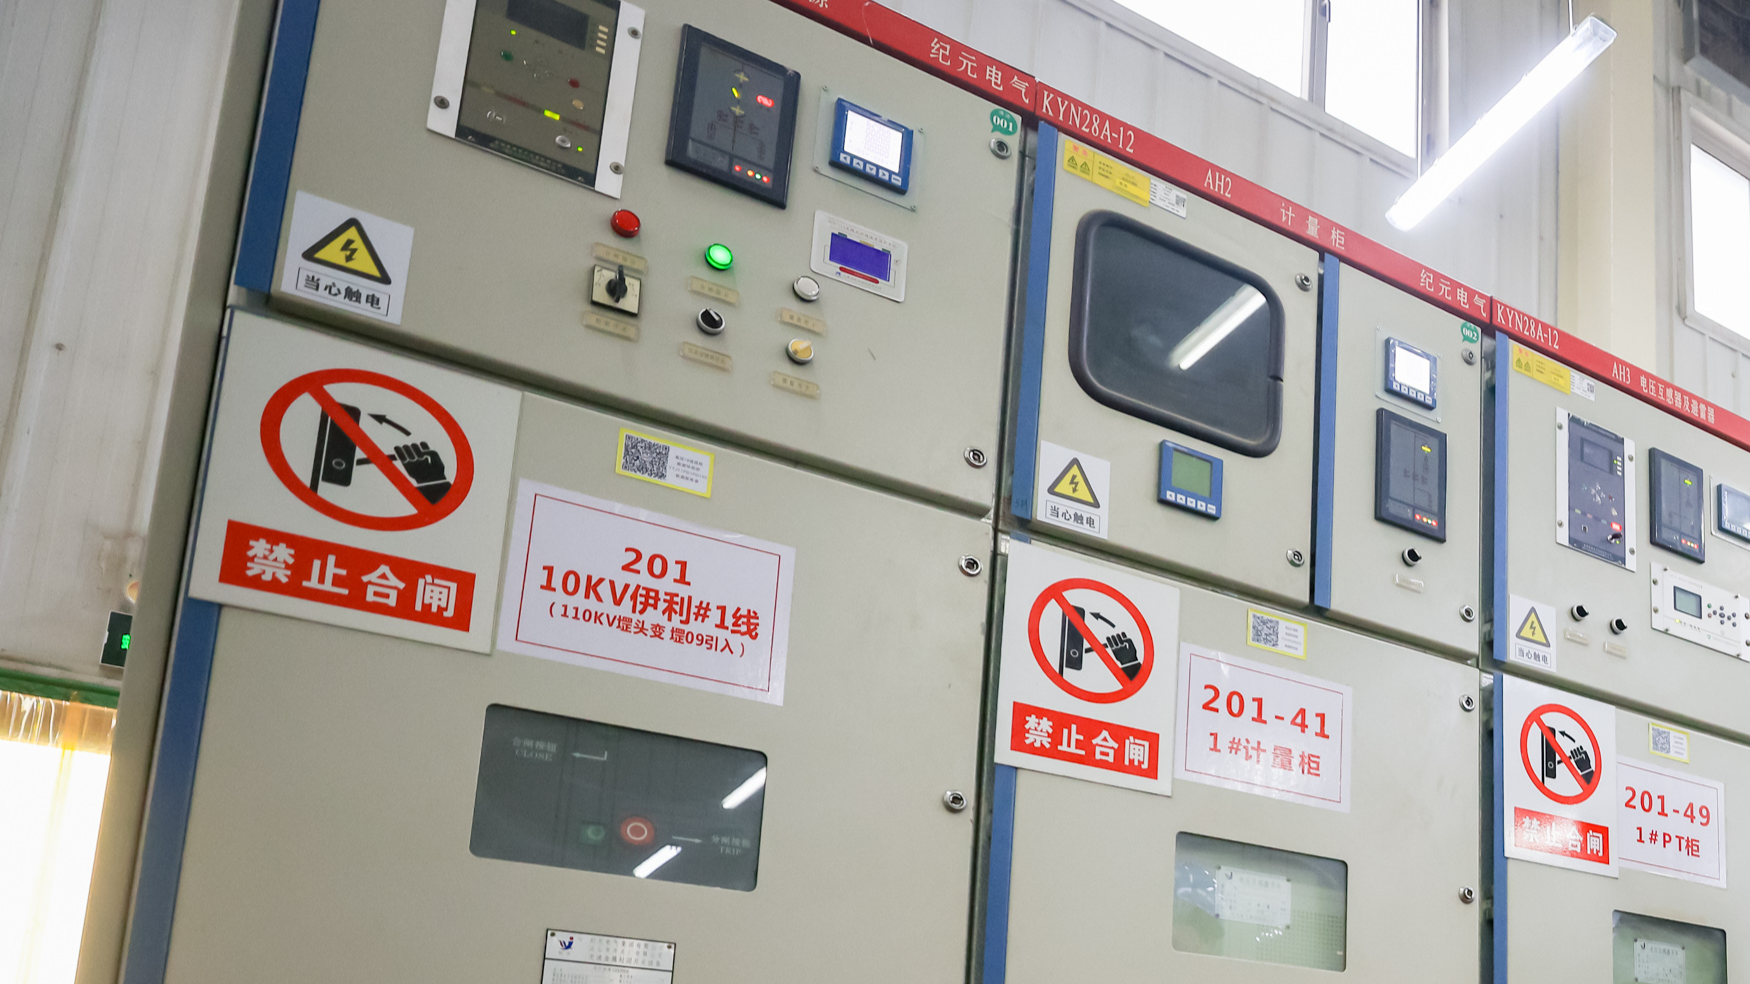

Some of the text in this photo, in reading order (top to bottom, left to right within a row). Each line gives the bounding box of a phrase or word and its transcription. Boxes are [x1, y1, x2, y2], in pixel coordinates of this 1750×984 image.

[930, 37, 1030, 105] 纪元电气
[993, 115, 1013, 132] 001
[1041, 88, 1135, 154] KYN28A-12
[1203, 168, 1232, 199] AH2
[1280, 203, 1346, 252] 计量柜
[303, 273, 383, 311] 当心触电
[1419, 268, 1487, 318] 纪元电气
[1463, 327, 1477, 341] 002
[1496, 303, 1559, 350] KYN28A-12
[1612, 361, 1631, 384] AH3
[1639, 375, 1715, 425] 电压互感器及避雷器
[1049, 504, 1096, 530] 当心触电
[246, 538, 457, 618] 禁止合闸
[621, 547, 691, 586] 201
[540, 565, 759, 640] 10KV伊利#1线
[1517, 648, 1549, 666] 当心触电
[1201, 684, 1330, 739] 201-41
[1024, 714, 1150, 770] 禁止合闸
[1208, 732, 1321, 779] 1#计量柜
[1624, 785, 1711, 827] 201-49
[1522, 816, 1604, 857] 禁止合闸
[1636, 825, 1700, 858] 1#PT柜
